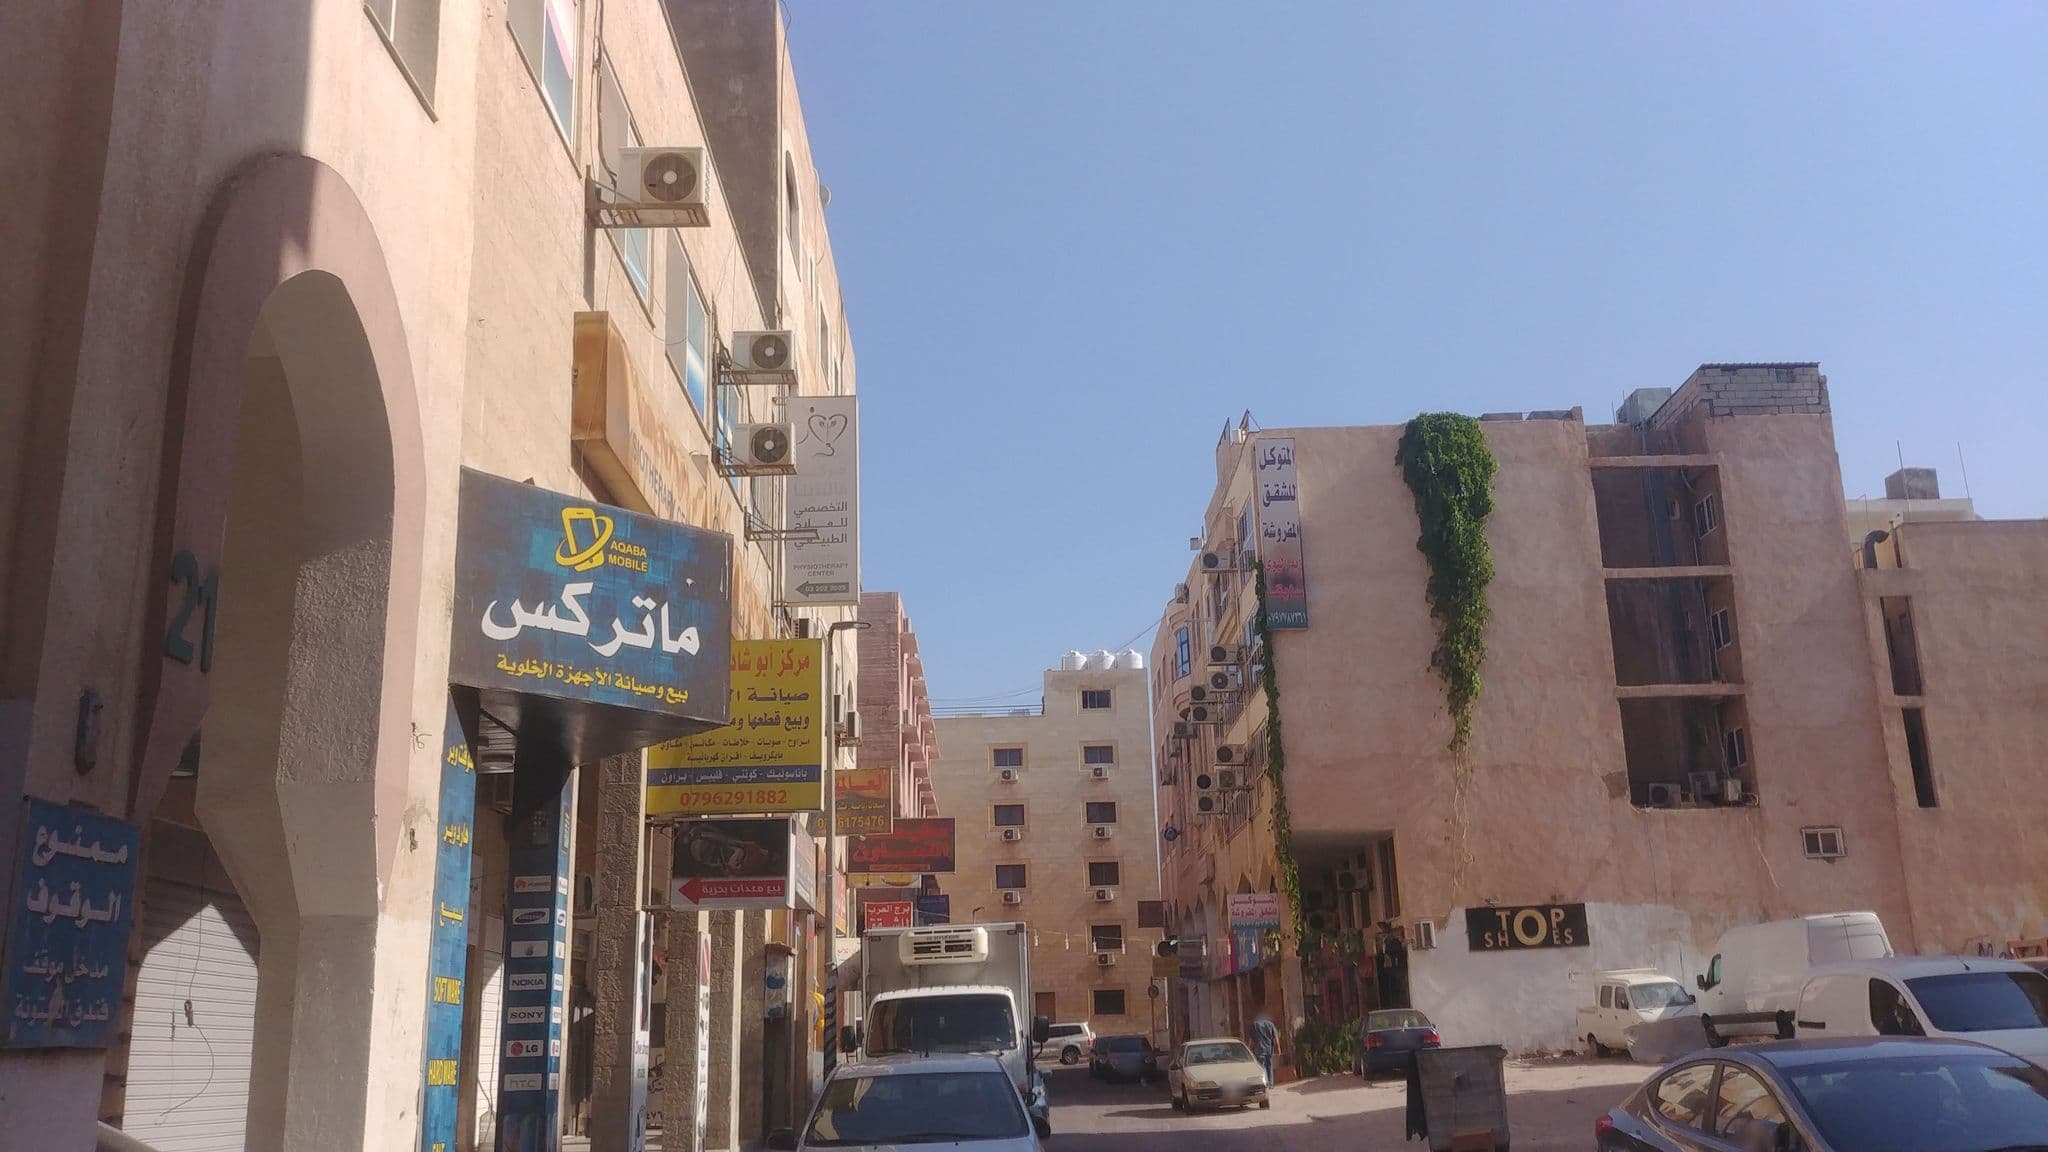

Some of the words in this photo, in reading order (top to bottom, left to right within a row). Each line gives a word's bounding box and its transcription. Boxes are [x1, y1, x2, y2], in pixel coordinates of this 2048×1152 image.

[1260, 446, 1295, 470] المتوكل
[1263, 482, 1296, 507] للشقق
[793, 501, 848, 518] التخصصي
[1263, 521, 1301, 542] المفروشة
[610, 540, 648, 559] AQABA
[608, 556, 649, 573] MOBILE
[481, 582, 700, 657] ماتركس
[496, 654, 553, 678] الخلوية
[777, 648, 810, 677] مركز
[556, 664, 612, 687] الأجهزة
[614, 673, 664, 699] وصيانة
[666, 686, 689, 704] بيع
[747, 688, 809, 705] صيانة
[748, 711, 780, 729] قطعها
[785, 714, 809, 731] وبيع
[680, 790, 787, 806] 0796291882
[817, 815, 884, 830] 06175476
[32, 825, 128, 866] ممنوع
[27, 877, 121, 928] الوقوف
[868, 905, 893, 915] العرب
[894, 905, 910, 915] برج
[1496, 908, 1565, 945] TOP
[511, 978, 545, 987] NOKIA
[510, 1011, 543, 1020] SONY
[525, 1044, 538, 1054] LG
